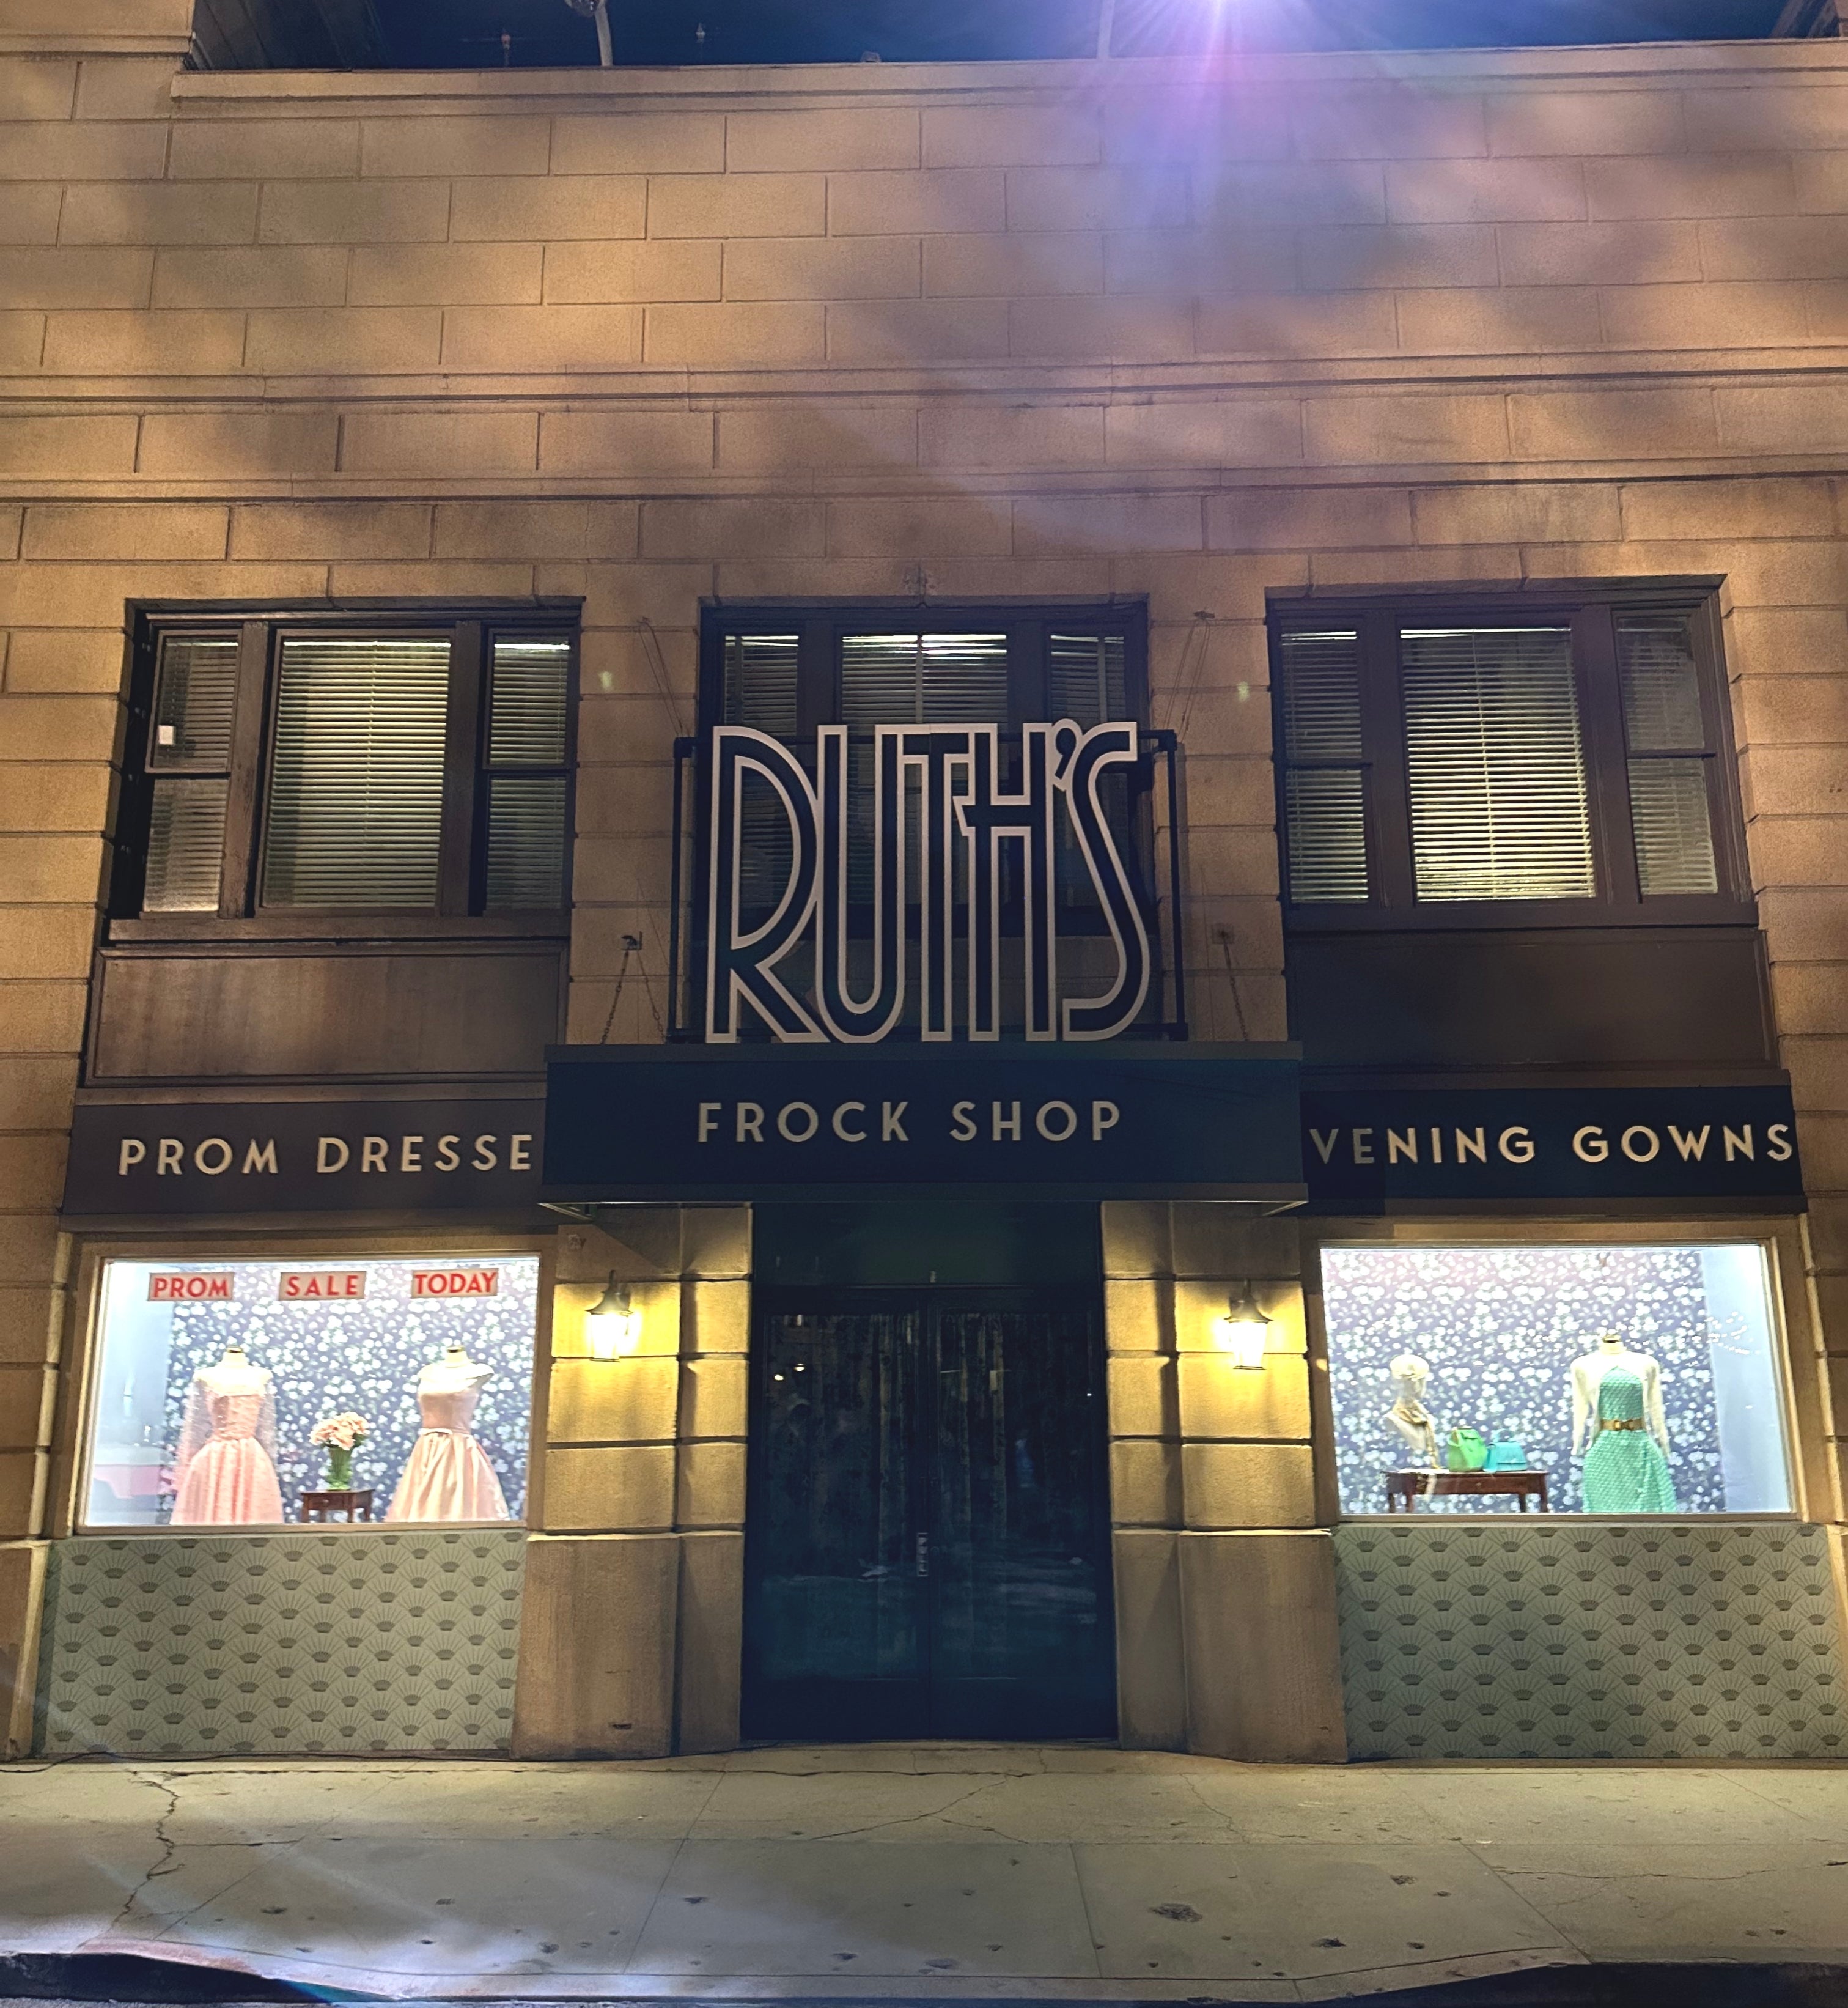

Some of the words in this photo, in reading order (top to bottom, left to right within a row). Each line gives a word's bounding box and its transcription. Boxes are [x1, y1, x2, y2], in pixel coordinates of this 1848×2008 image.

[705, 719, 1150, 1044] RUTH'S
[698, 1101, 910, 1143] FROCK
[949, 1100, 1121, 1142] SHOP
[118, 1137, 279, 1175] PROM
[317, 1134, 532, 1173] DRESSE
[1309, 1126, 1536, 1165] VENING
[1572, 1123, 1793, 1164] GOWNS
[153, 1277, 230, 1298] PROM
[285, 1275, 359, 1297] SALE
[414, 1272, 498, 1295] TODAY
